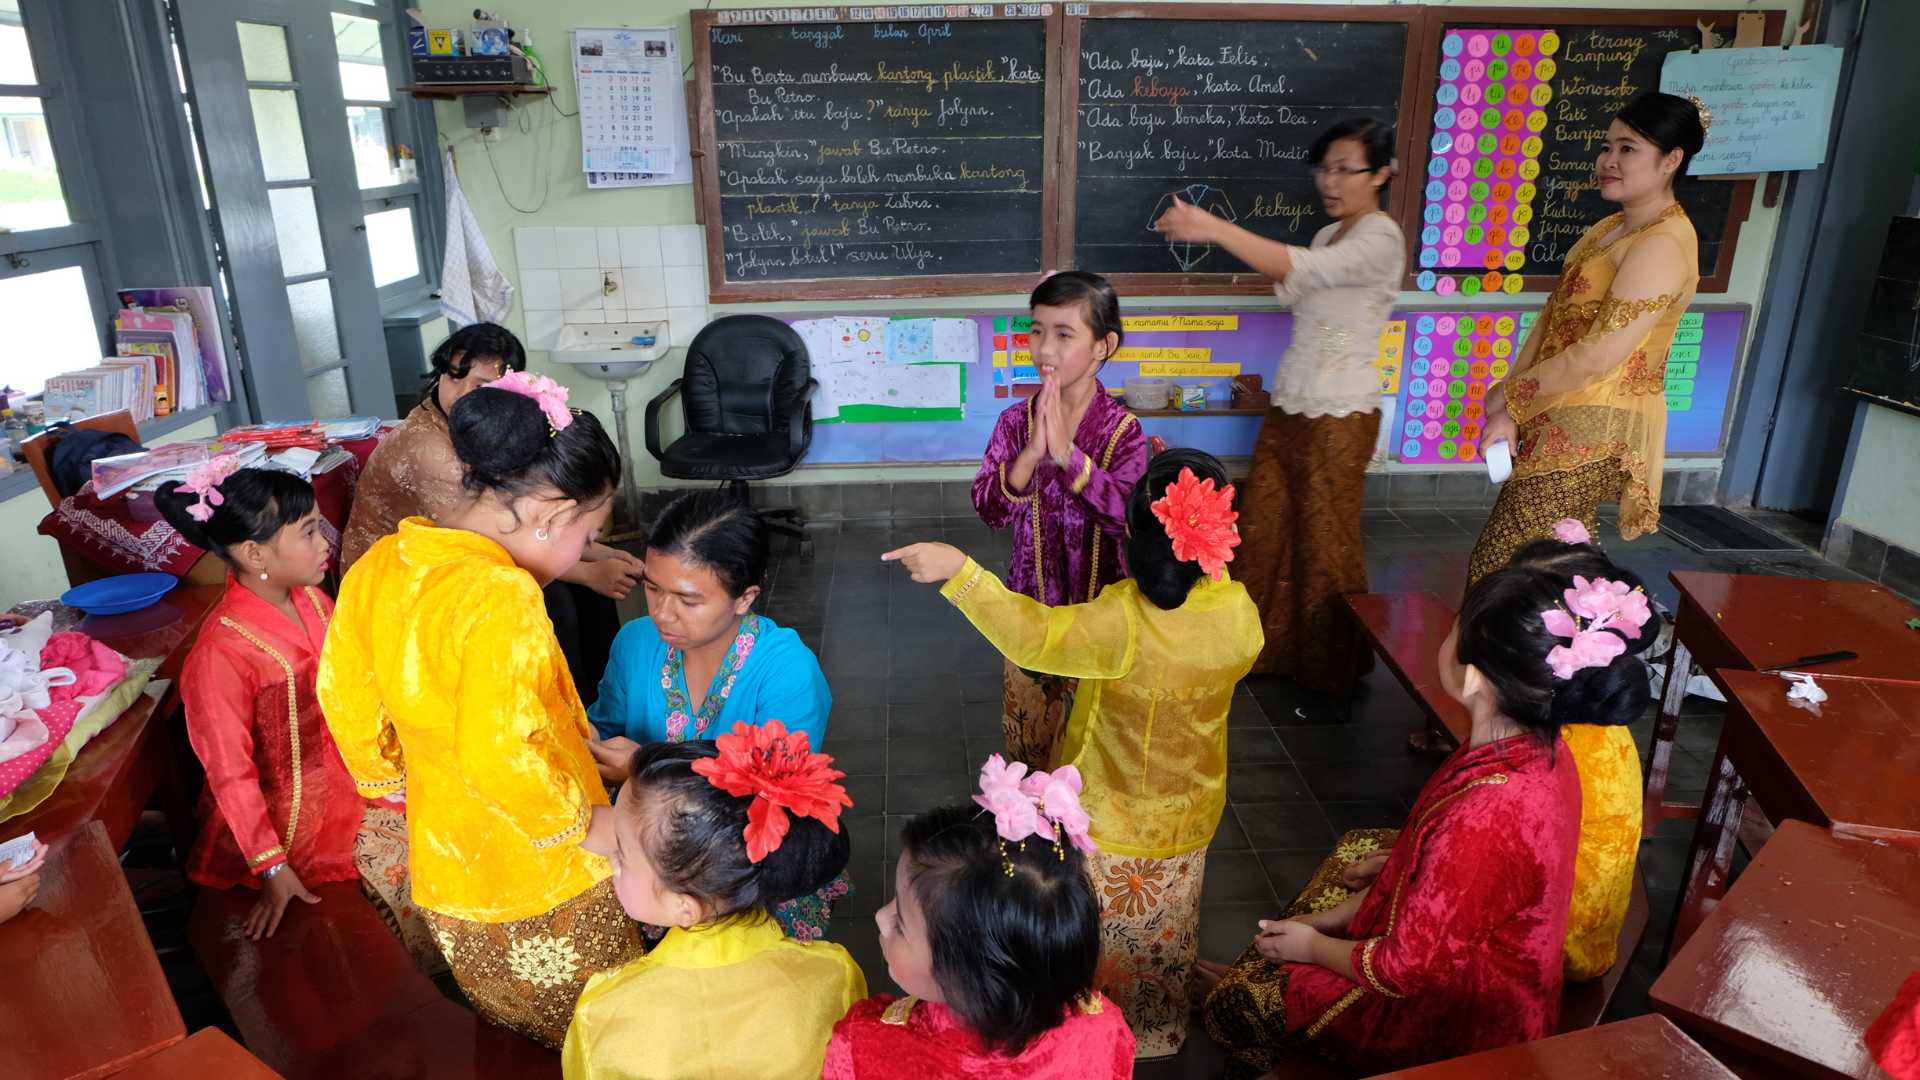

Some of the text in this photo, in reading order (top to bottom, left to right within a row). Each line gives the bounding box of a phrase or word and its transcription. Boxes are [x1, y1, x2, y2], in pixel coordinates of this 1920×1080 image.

[912, 7, 920, 16] 17
[791, 27, 845, 49] tanggal
[874, 24, 908, 38] bulan
[918, 23, 952, 47] April
[1174, 45, 1214, 66] kata
[1565, 40, 1639, 71] Lampung
[878, 61, 935, 92] kantong
[1203, 72, 1242, 93] kata
[1560, 75, 1639, 96] Wonosobo
[748, 88, 773, 105] Bu
[790, 107, 816, 121] itu
[887, 104, 933, 128] tanya
[1128, 104, 1166, 135] baju
[1237, 105, 1274, 126] kata
[1556, 100, 1587, 121] Pati
[868, 138, 892, 156] Bu
[1213, 137, 1250, 160] kata
[792, 174, 838, 192] saya
[840, 164, 880, 185] boleh
[960, 161, 1030, 188] kantong
[832, 199, 880, 218] tanya
[1245, 193, 1315, 232] kebaya
[857, 218, 880, 235] Bu
[846, 251, 889, 262] seru
